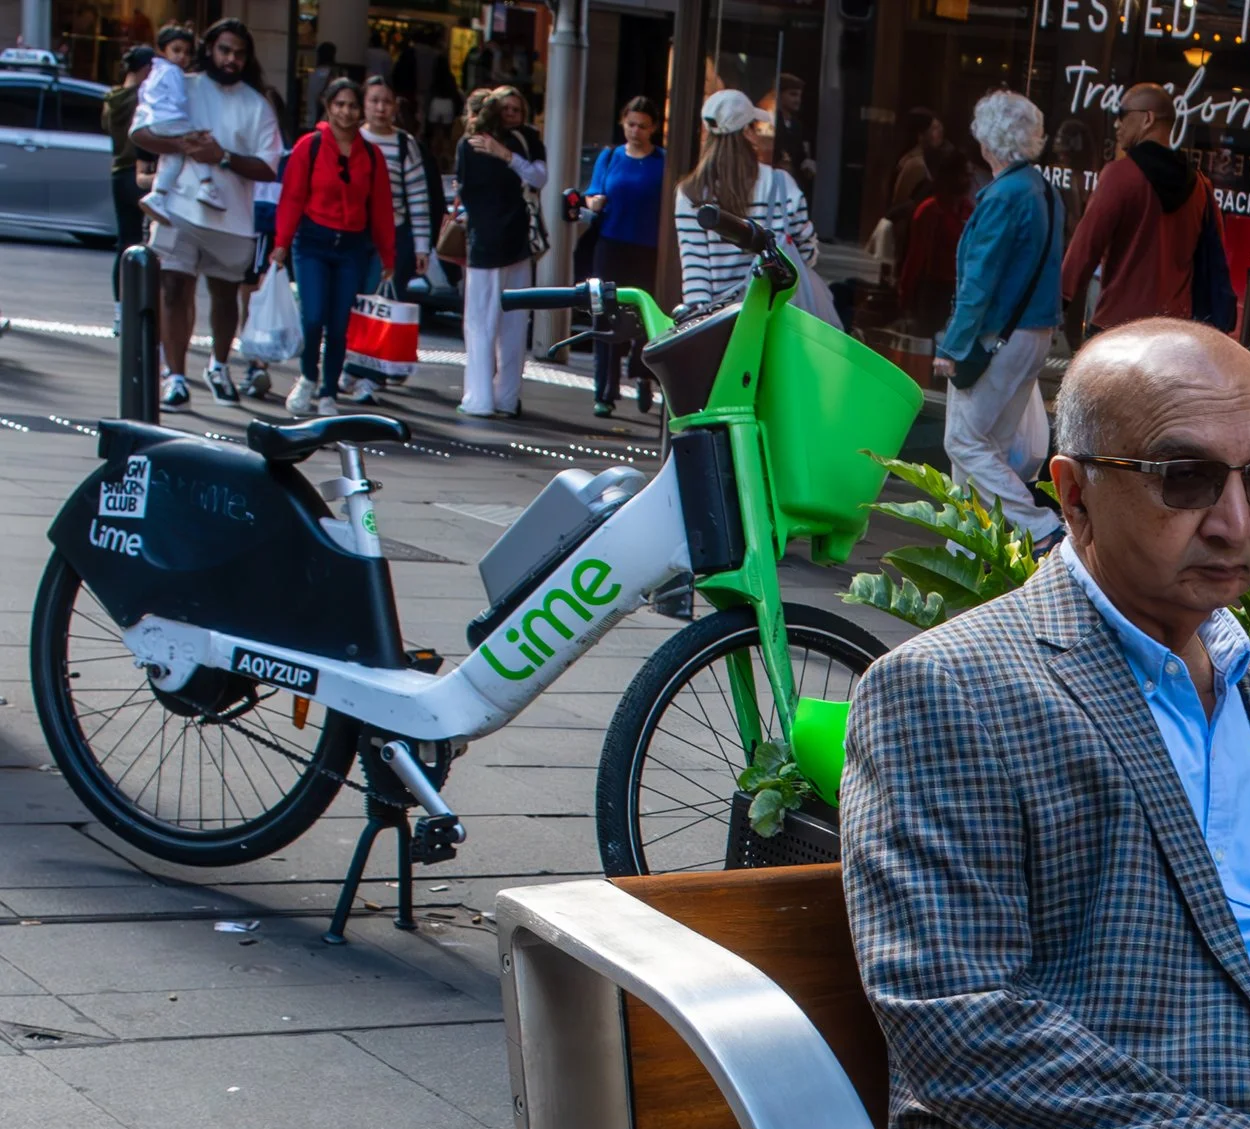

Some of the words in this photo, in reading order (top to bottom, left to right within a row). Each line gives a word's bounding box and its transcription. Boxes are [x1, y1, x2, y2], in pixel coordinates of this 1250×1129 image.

[105, 495, 137, 512] CLUB
[89, 518, 142, 556] Lime
[479, 558, 622, 681] Lime
[238, 653, 312, 687] AQYZUP
